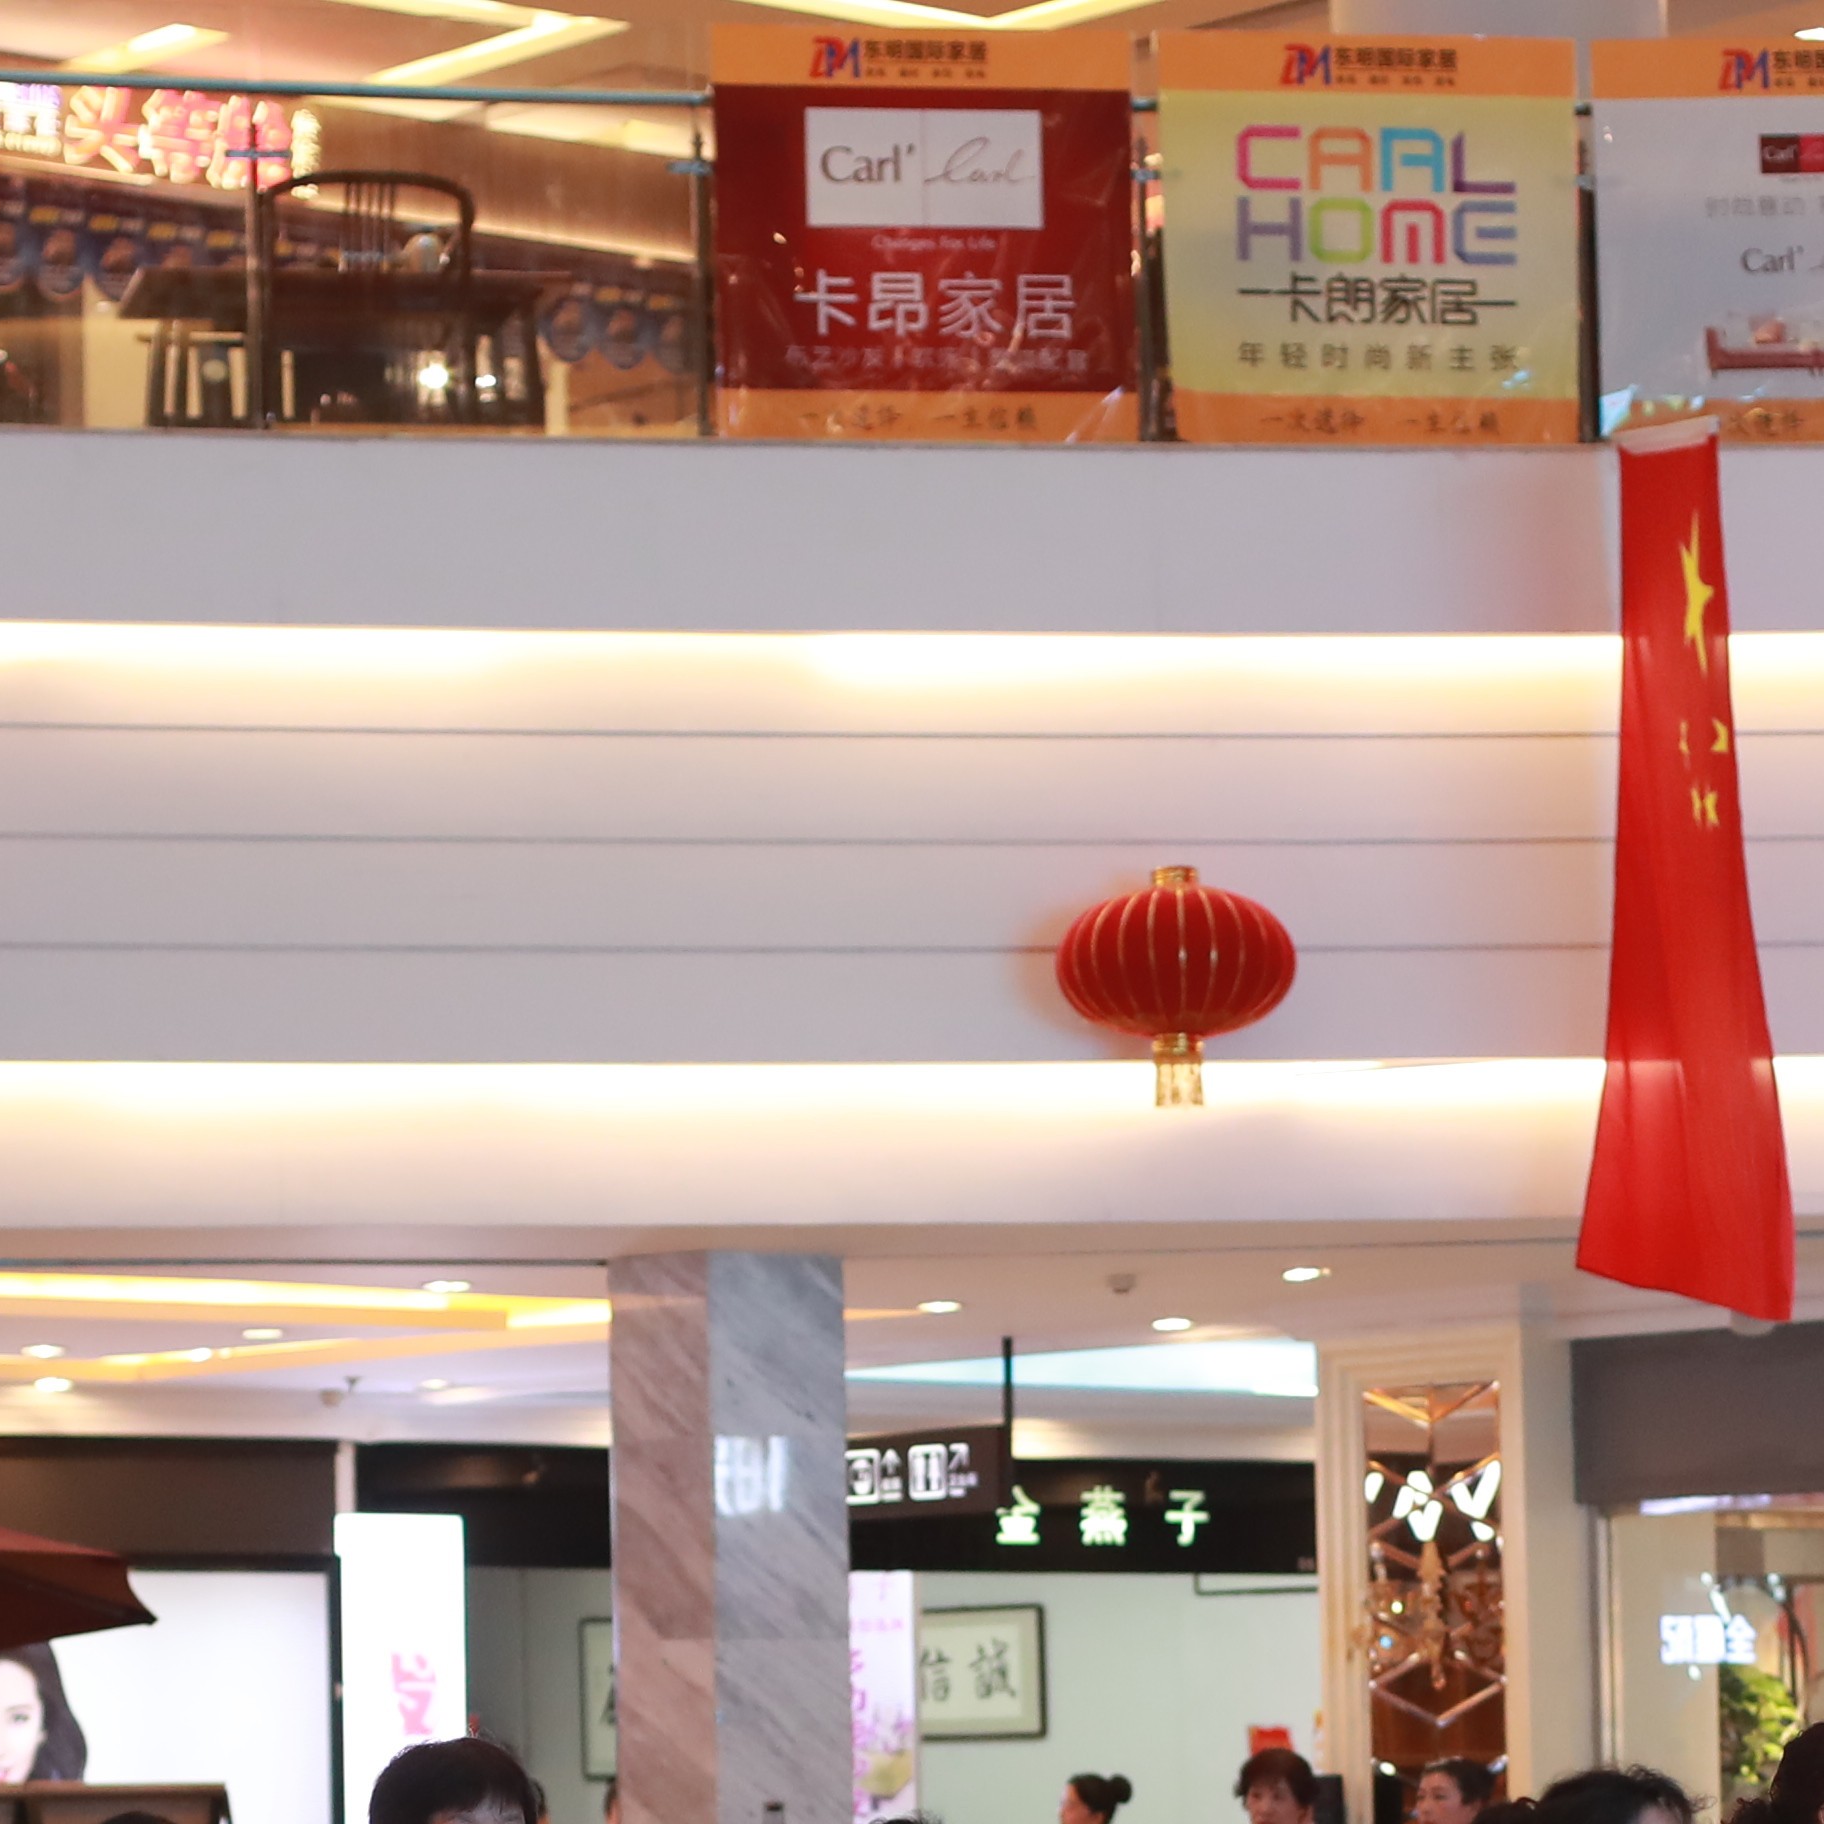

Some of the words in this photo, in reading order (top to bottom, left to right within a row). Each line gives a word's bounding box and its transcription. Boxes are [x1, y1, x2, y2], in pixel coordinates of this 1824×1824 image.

[1236, 124, 1517, 194] CARL
[1236, 197, 1517, 264] HOME
[794, 268, 1076, 339] 卡昂家居
[1238, 341, 1519, 372] 年轻时尚新主张
